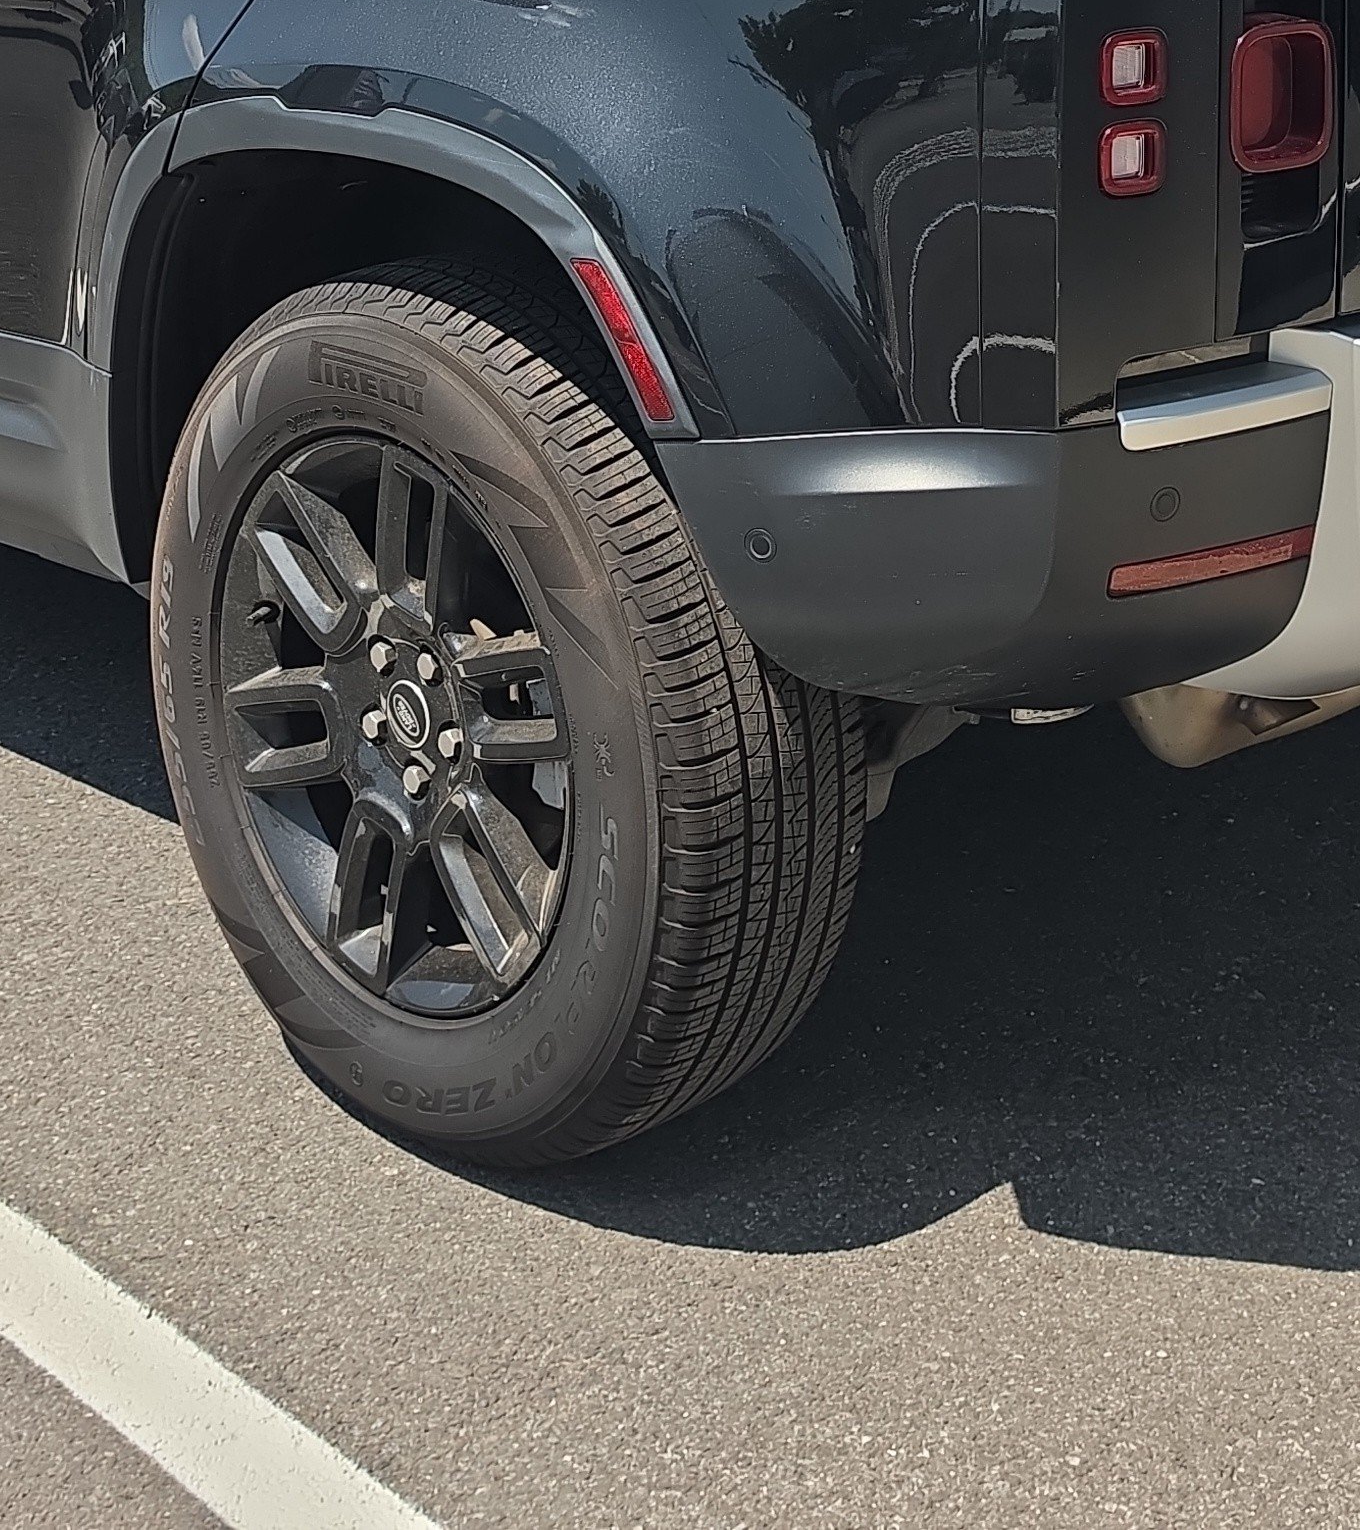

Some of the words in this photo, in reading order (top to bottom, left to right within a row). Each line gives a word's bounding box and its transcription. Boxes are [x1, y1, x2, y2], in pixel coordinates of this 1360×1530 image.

[308, 339, 429, 417] PIRELLI
[158, 555, 174, 651] R19
[383, 1077, 497, 1117] ZERO
